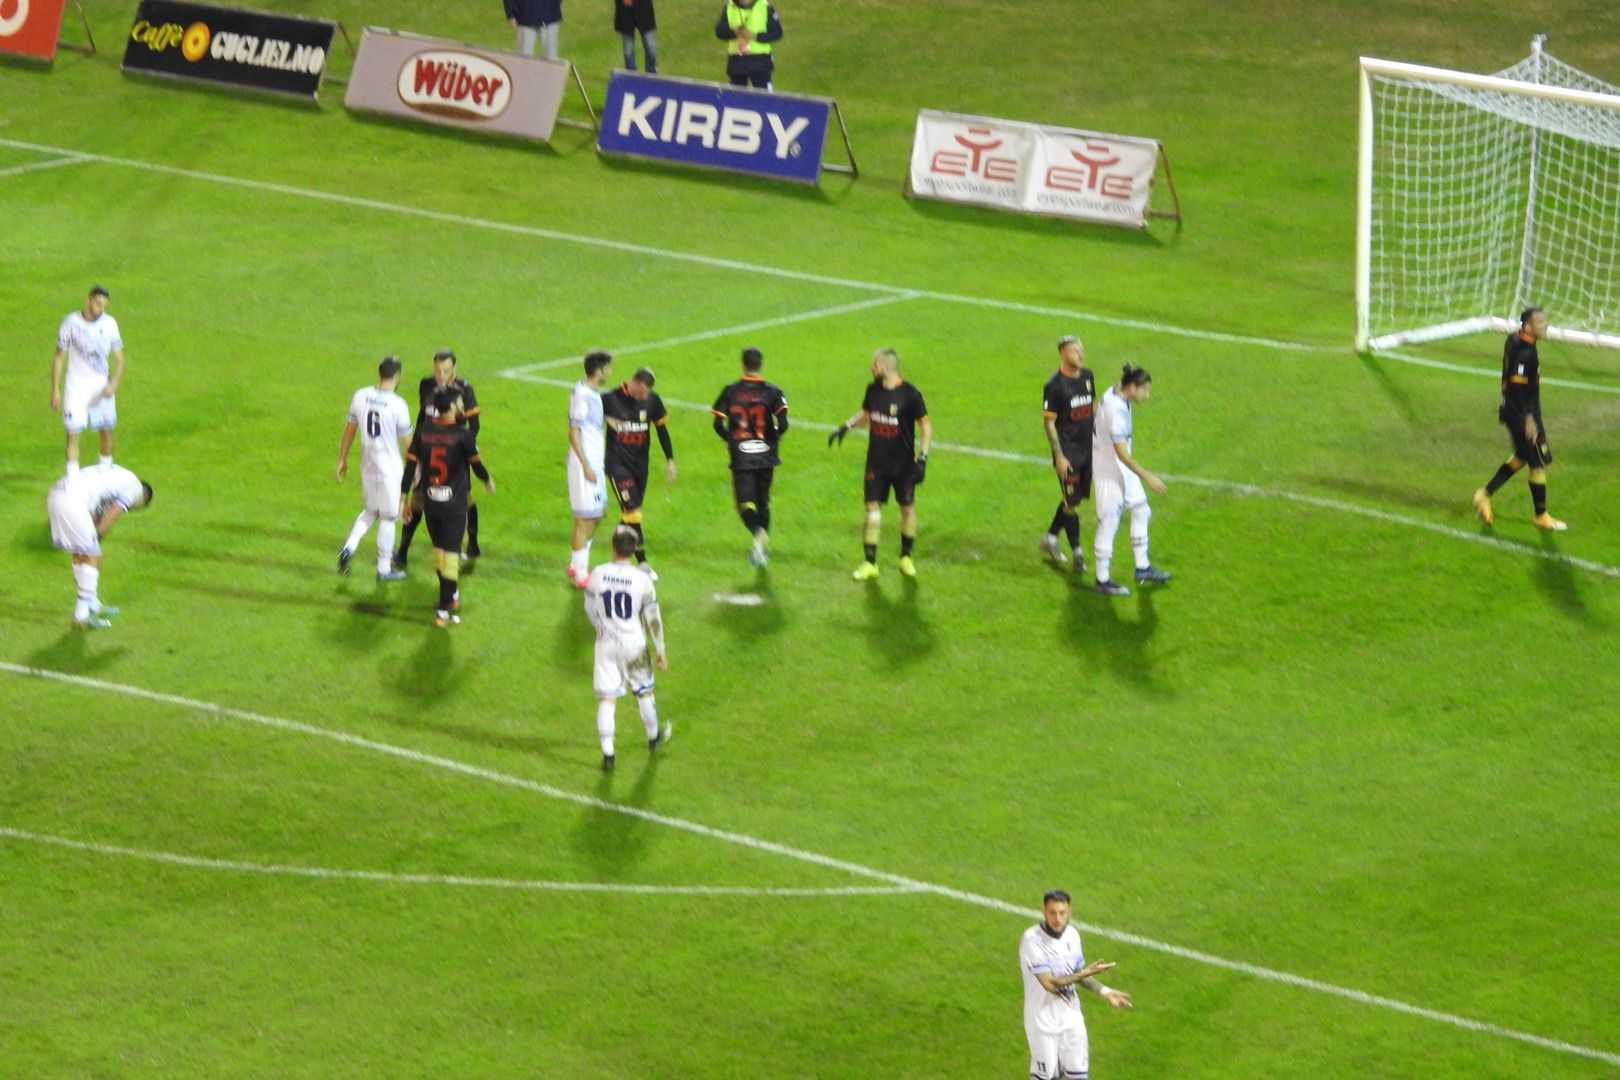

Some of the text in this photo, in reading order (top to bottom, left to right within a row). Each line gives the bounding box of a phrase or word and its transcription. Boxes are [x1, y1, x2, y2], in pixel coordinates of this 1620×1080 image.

[414, 57, 503, 106] Wüber
[618, 92, 809, 160] KIRBY
[367, 410, 381, 438] 6
[430, 446, 448, 486] 5
[600, 590, 632, 620] 10
